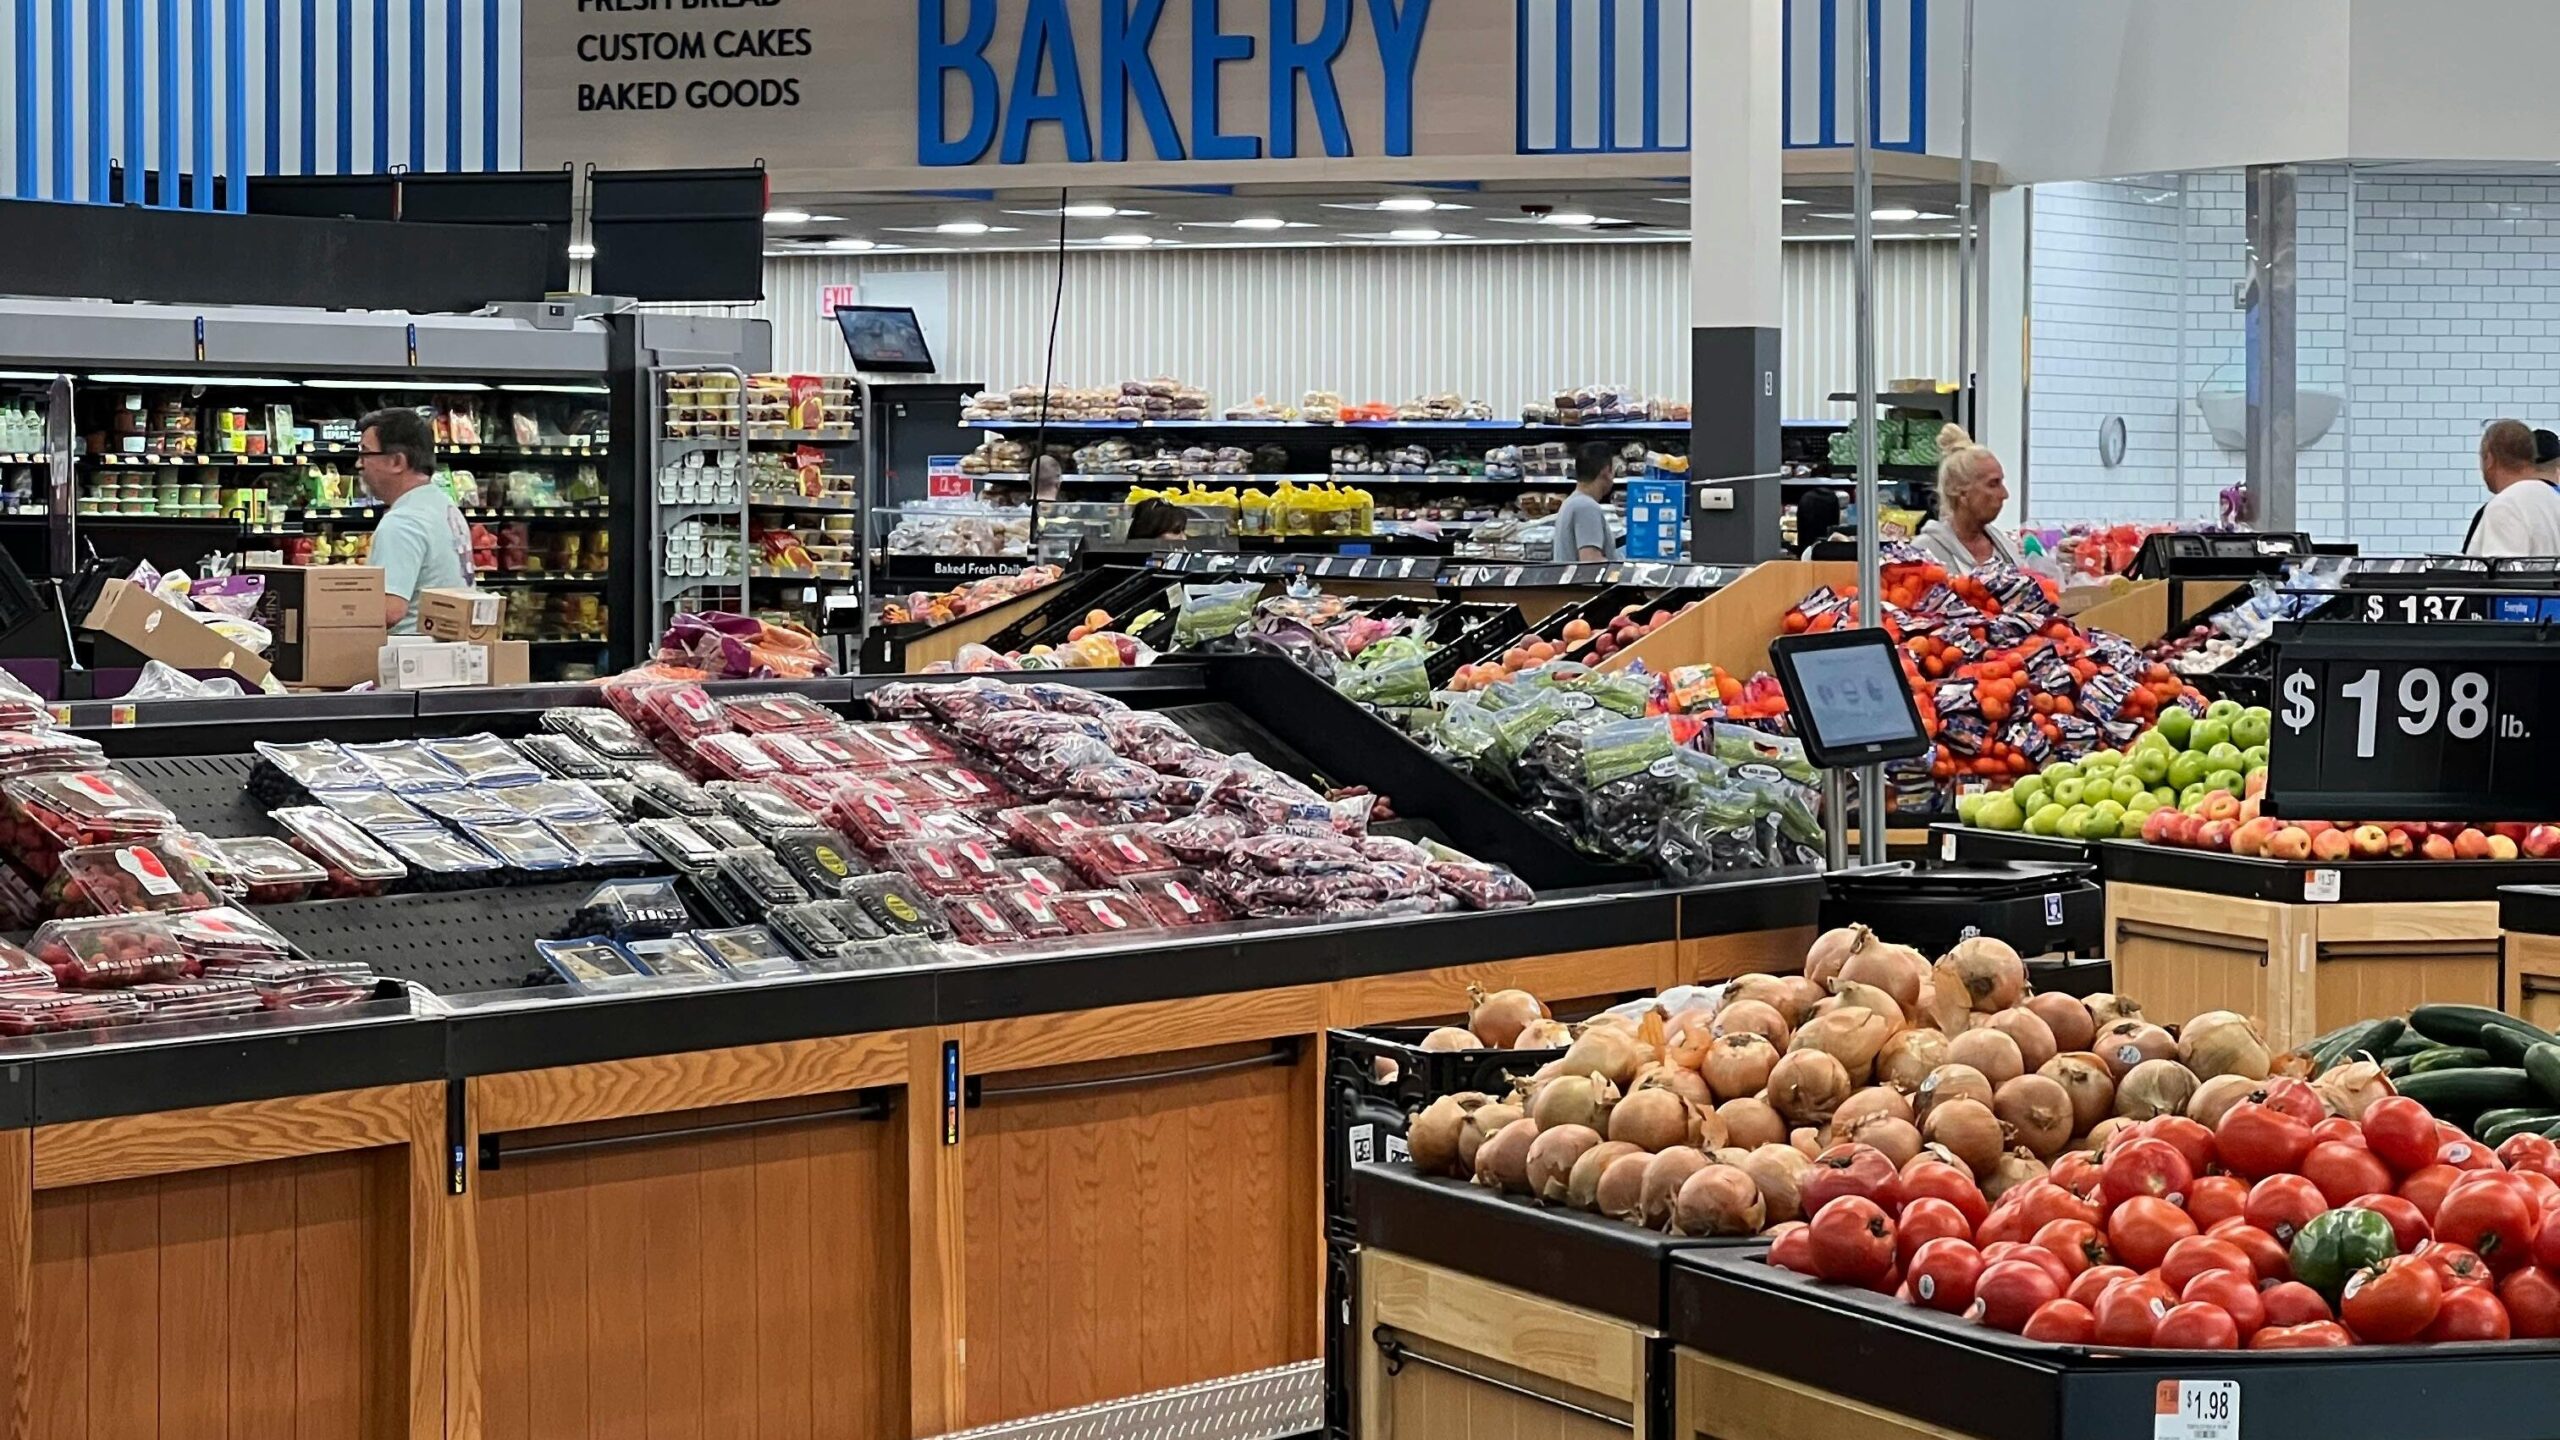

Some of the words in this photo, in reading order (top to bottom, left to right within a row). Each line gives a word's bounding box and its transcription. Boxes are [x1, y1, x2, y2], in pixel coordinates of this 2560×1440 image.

[577, 31, 706, 62] CUSTOM
[713, 28, 812, 58] CAKES
[577, 82, 677, 111] BAKED
[685, 78, 800, 109] GOODS
[917, 0, 1432, 166] BAKERY
[823, 287, 853, 313] EXIT
[934, 562, 966, 574] Baked
[968, 563, 997, 575] Fresh
[2500, 714, 2531, 738] lb.
[2187, 1390, 2229, 1420] $1.98
